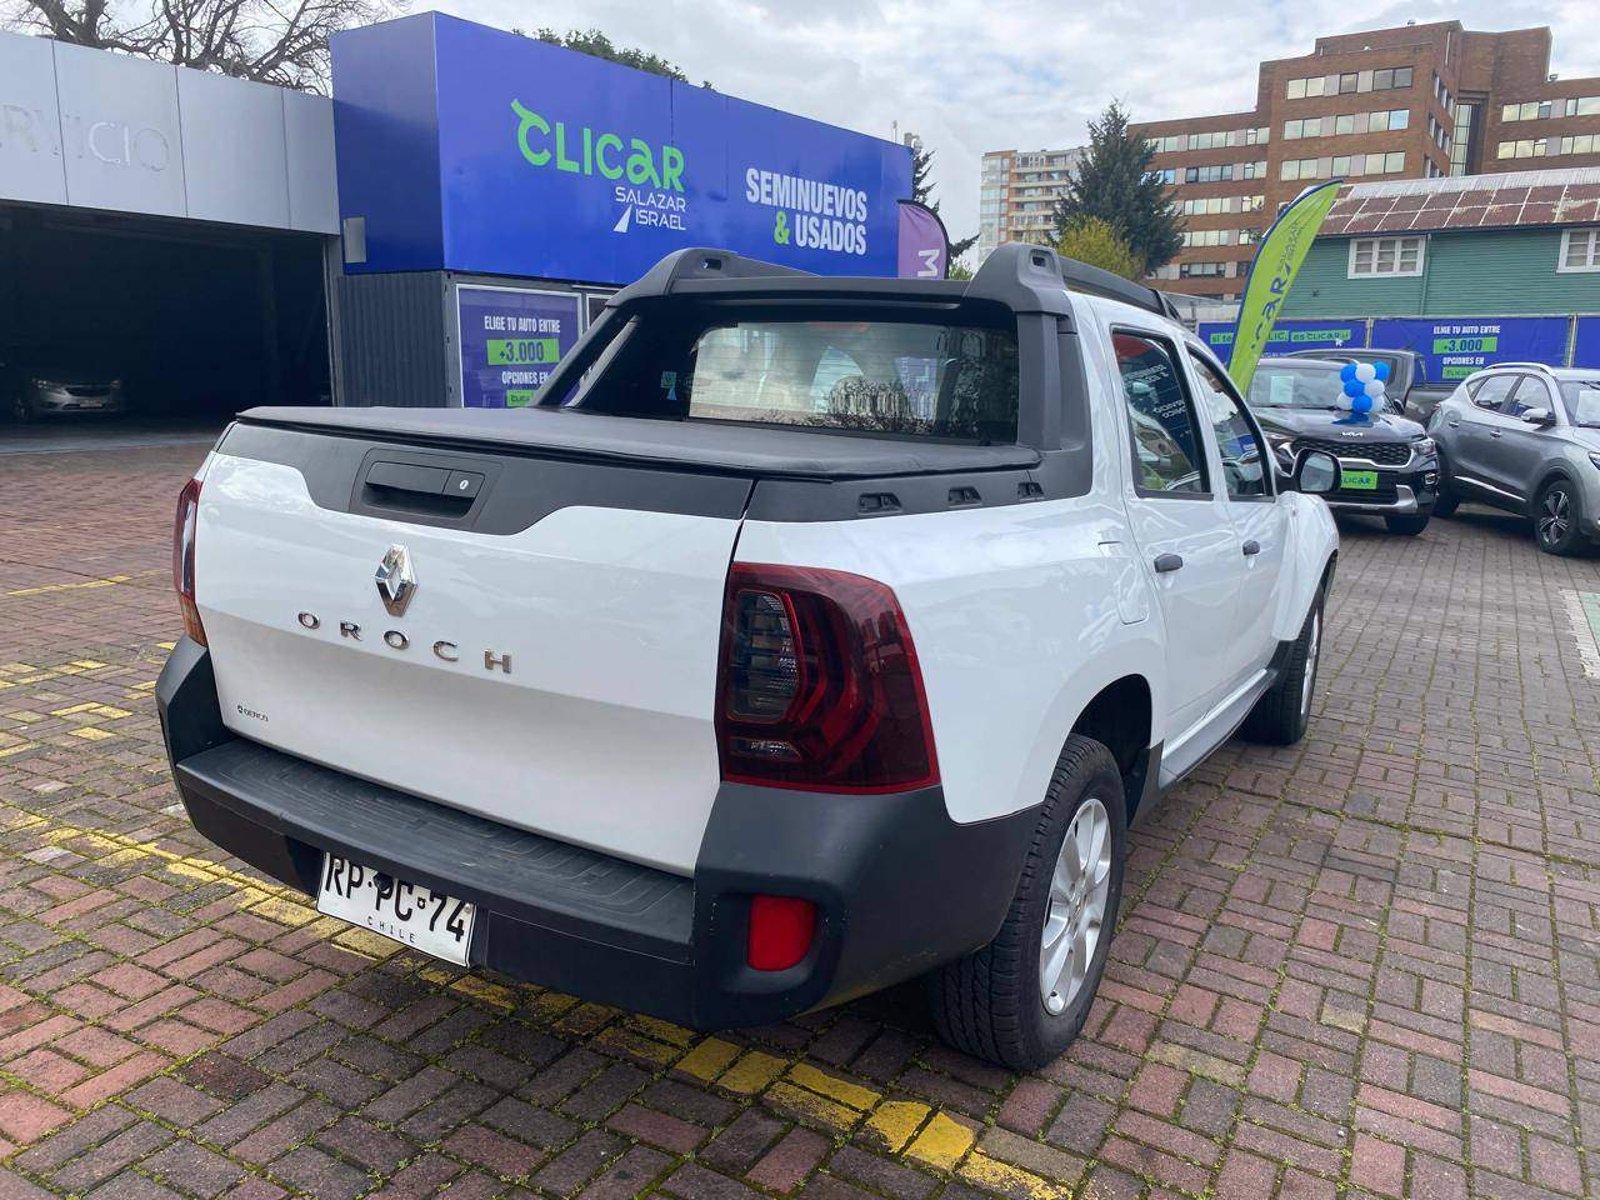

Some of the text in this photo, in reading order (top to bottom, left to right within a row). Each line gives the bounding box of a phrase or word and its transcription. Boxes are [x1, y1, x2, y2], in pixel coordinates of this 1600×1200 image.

[615, 186, 687, 213] SALAZAR
[746, 167, 868, 223] SEMINUEVOS
[635, 208, 687, 231] ISRAEL
[774, 210, 867, 256] & USADOS
[484, 315, 561, 333] ELIGE TU AUTO ENTRE
[502, 371, 538, 385] OPCIONES
[297, 609, 513, 675] OROCH
[366, 915, 416, 944] CHILE
